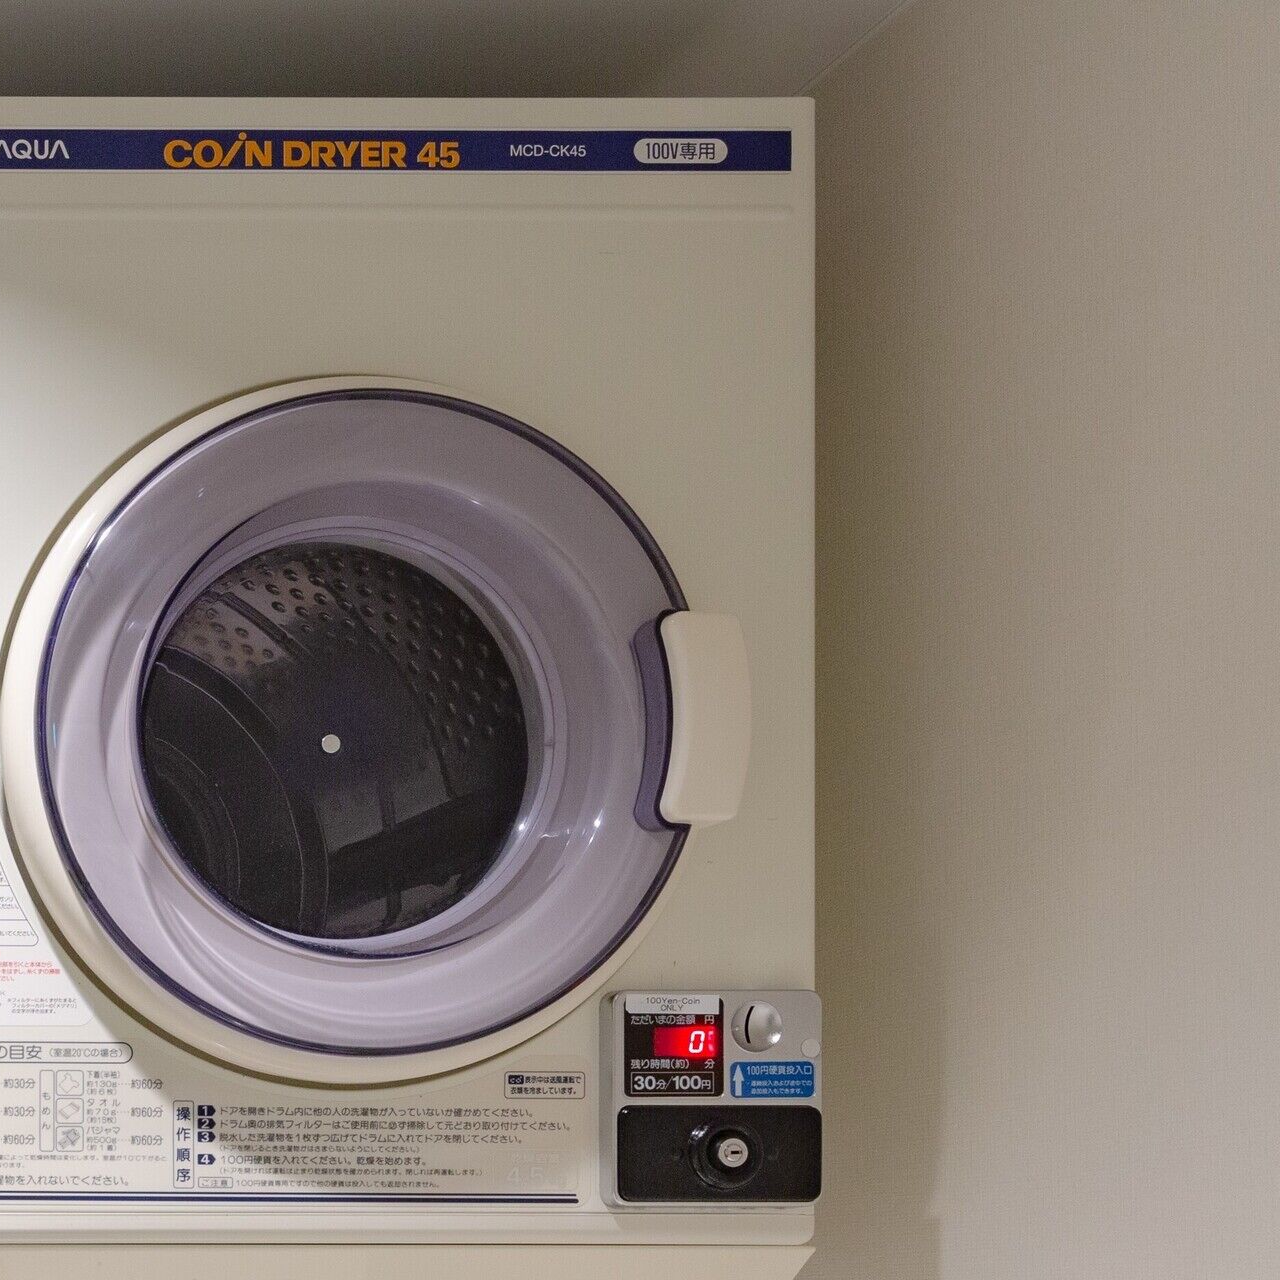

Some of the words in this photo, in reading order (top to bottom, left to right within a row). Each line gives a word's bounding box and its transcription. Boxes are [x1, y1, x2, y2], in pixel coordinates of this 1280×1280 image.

[163, 132, 274, 170] COIN
[283, 139, 407, 170] DRYER
[416, 139, 461, 169] 45
[509, 143, 587, 158] MCD-CK45
[643, 140, 717, 162] 100V専用
[630, 1015, 696, 1025] ただいまの金額
[689, 1030, 705, 1053] 0
[633, 1075, 712, 1090] 30分/100円
[176, 1107, 191, 1183] 操作順序
